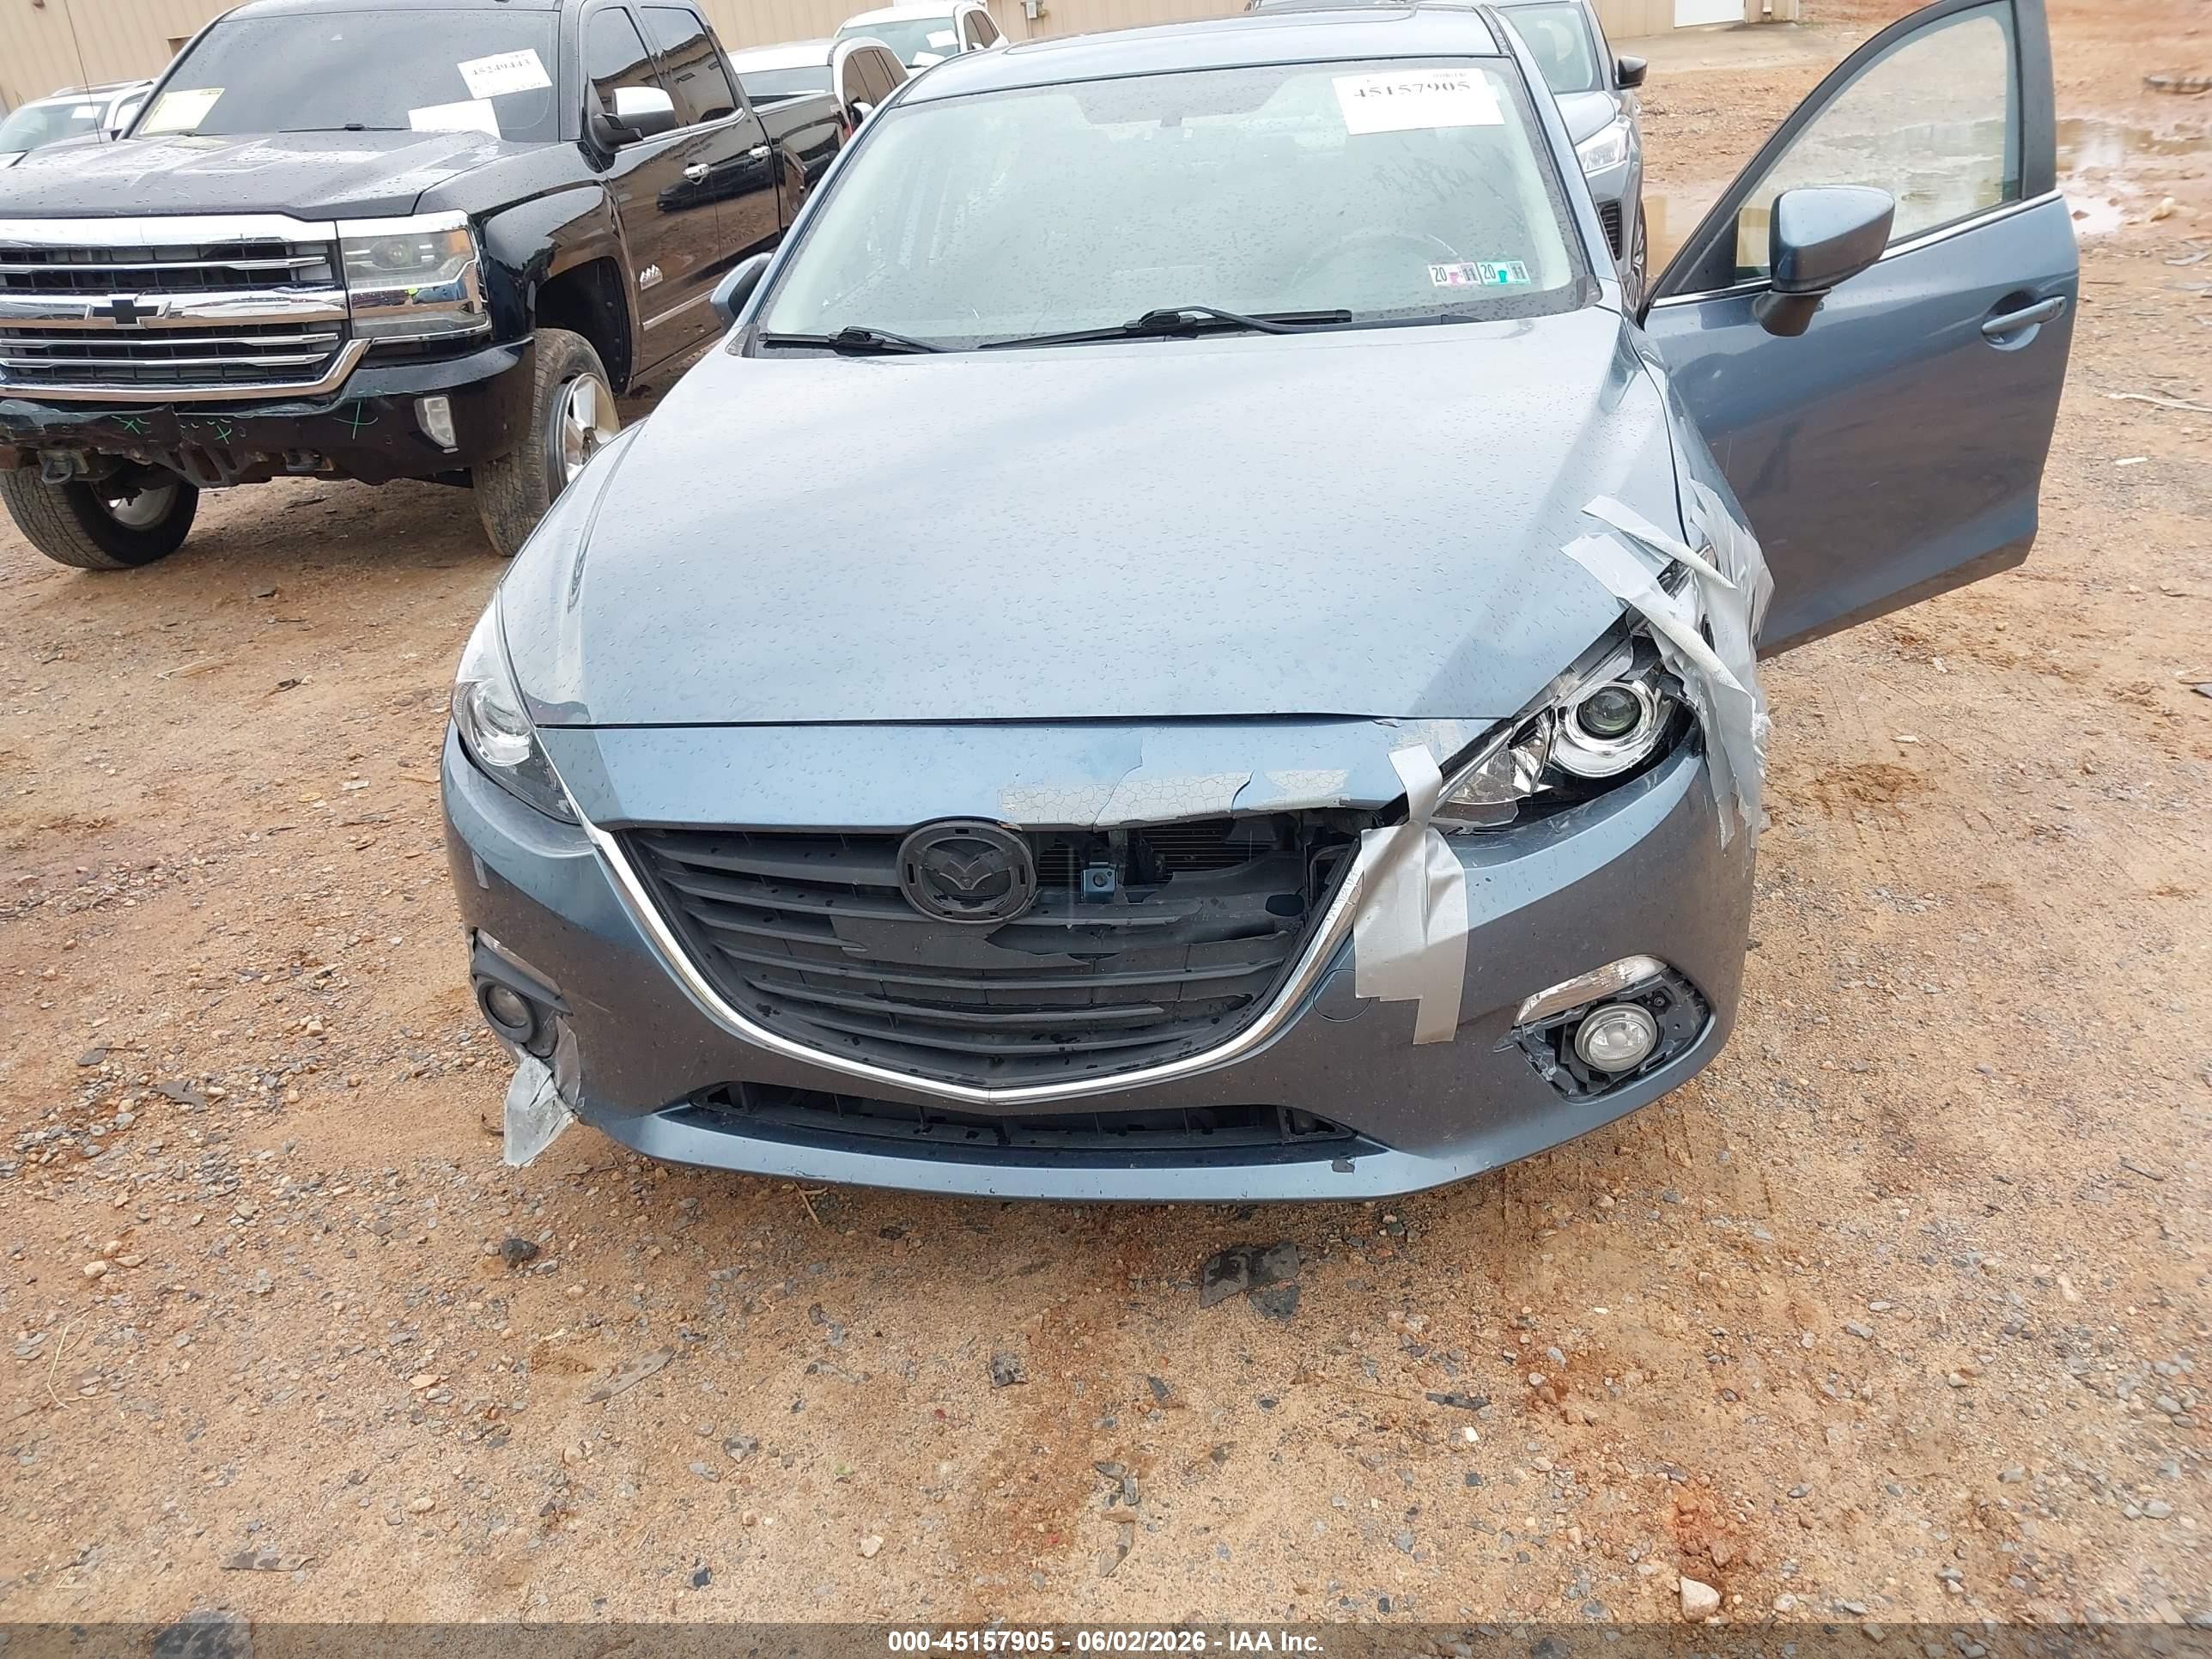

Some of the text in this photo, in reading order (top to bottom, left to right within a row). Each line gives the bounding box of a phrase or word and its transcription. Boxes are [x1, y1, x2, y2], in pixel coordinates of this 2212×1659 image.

[1353, 81, 1471, 98] 45157905
[1431, 265, 1478, 283] 20 11
[1480, 264, 1526, 280] 20 11
